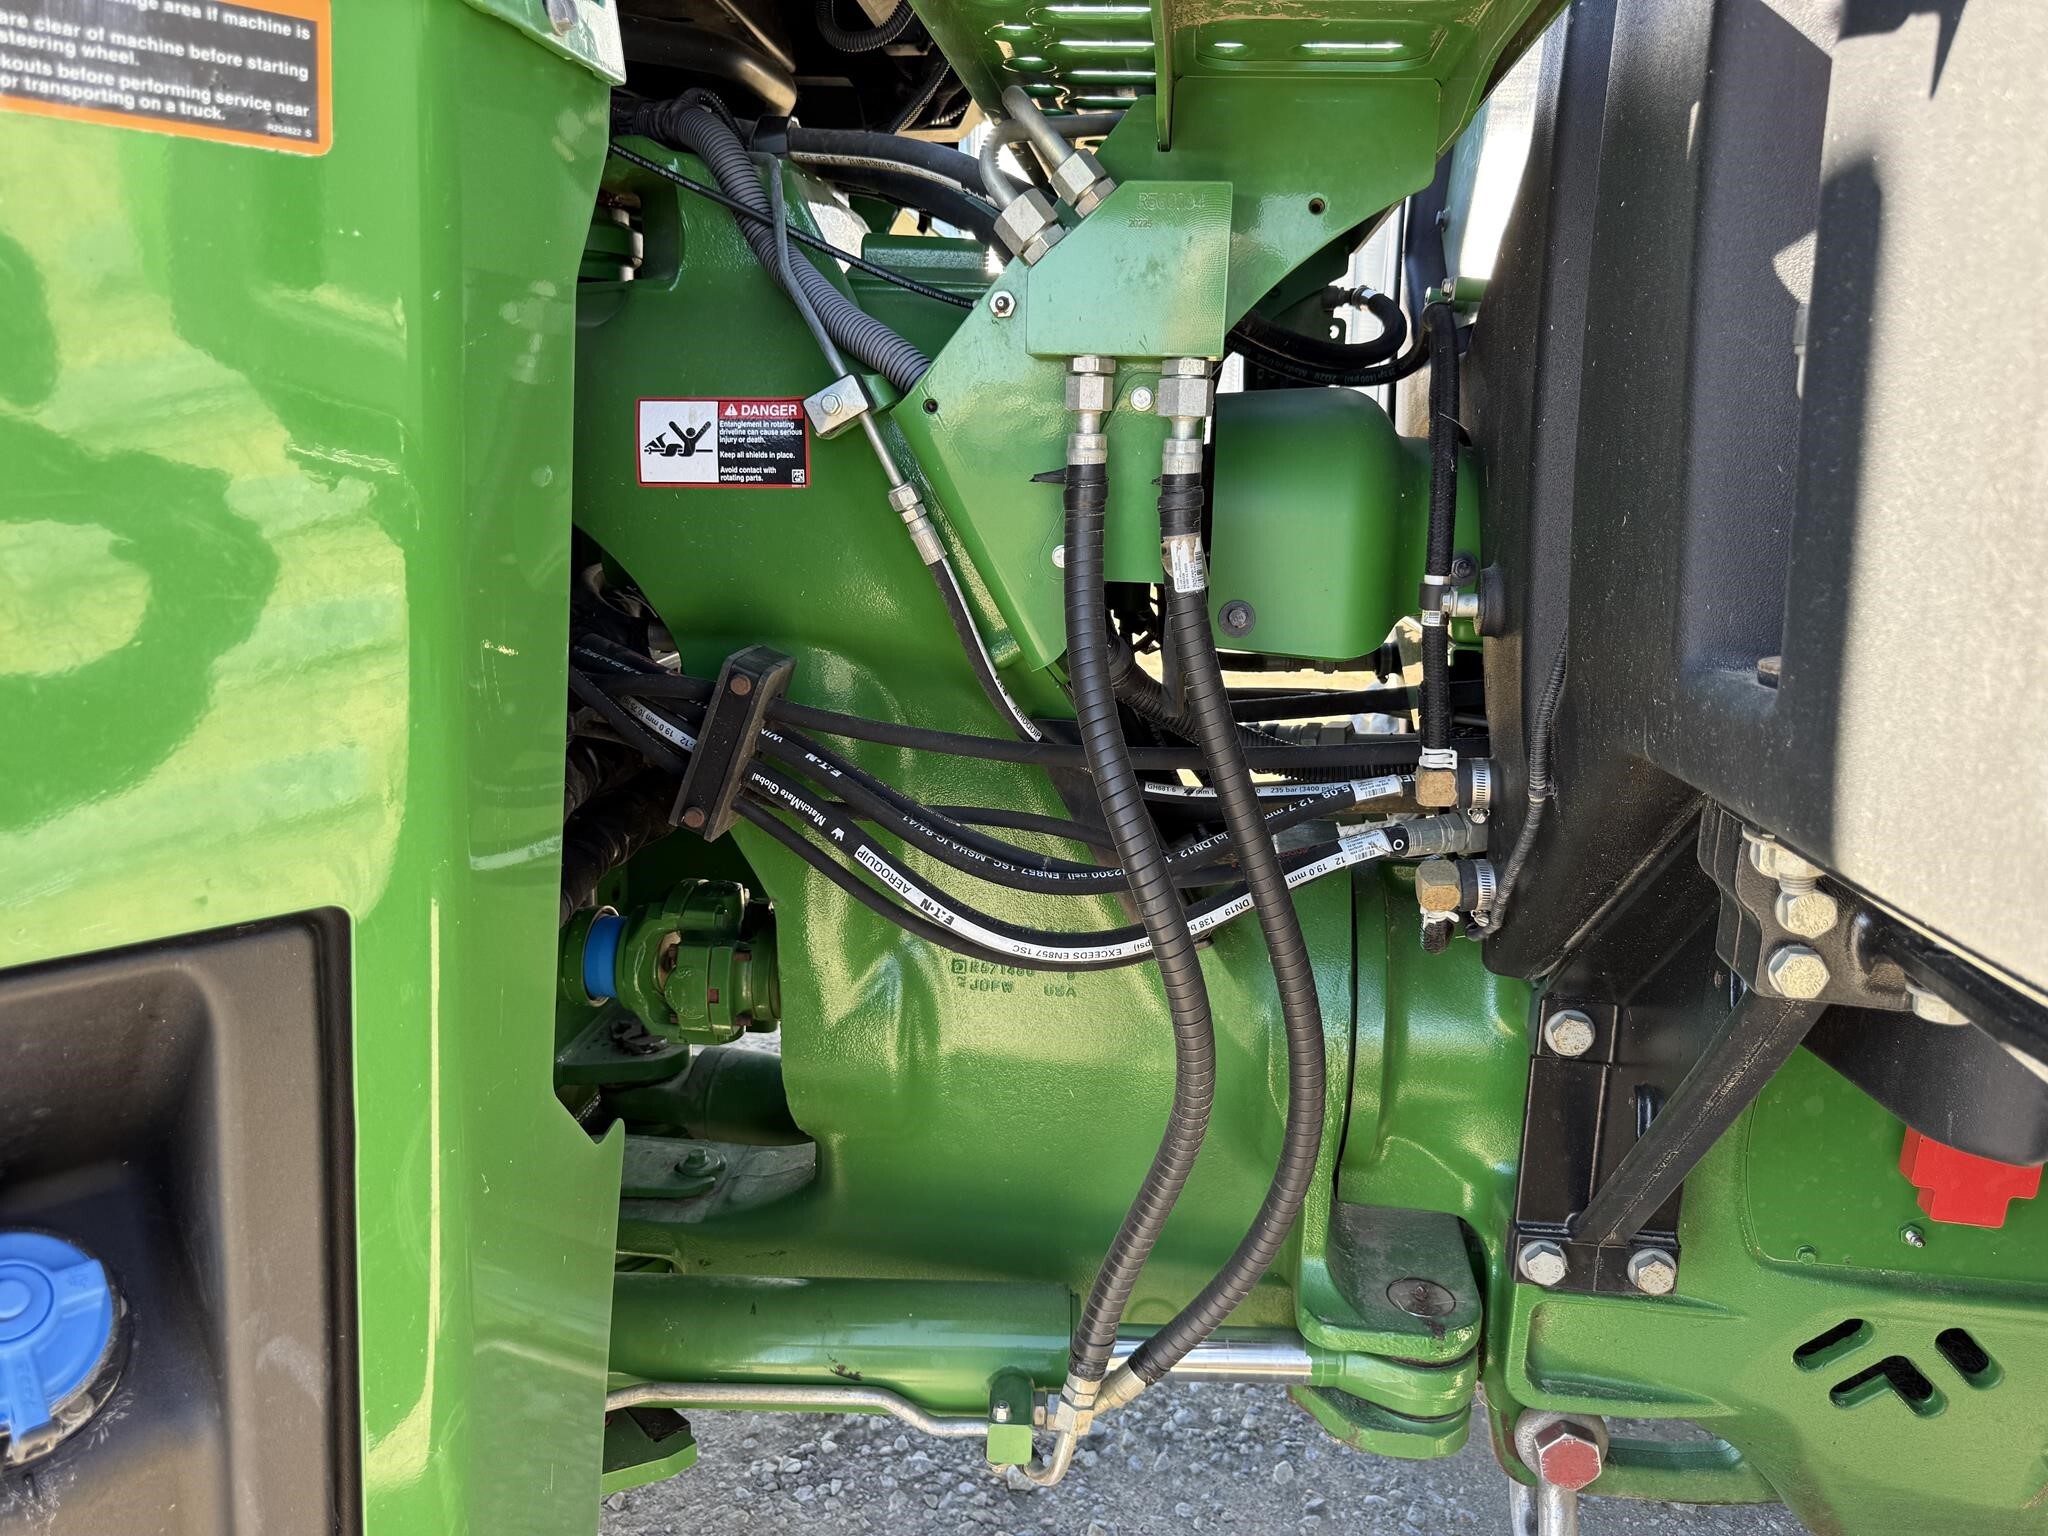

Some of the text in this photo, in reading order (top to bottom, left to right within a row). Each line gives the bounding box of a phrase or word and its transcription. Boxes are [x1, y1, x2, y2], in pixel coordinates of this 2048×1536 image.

[163, 1, 202, 19] area
[207, 6, 218, 22] if
[222, 11, 292, 36] machine
[295, 24, 310, 40] is
[0, 11, 309, 82] are clear of machine before starting
[0, 29, 140, 66] steering wheel.
[57, 61, 115, 86] before
[119, 74, 211, 105] performing
[215, 91, 272, 112] service
[275, 101, 309, 117] near
[23, 76, 135, 110] transporting
[138, 95, 161, 111] on
[165, 101, 176, 113] a
[179, 101, 226, 121] truck.
[741, 404, 798, 416] DANGER
[719, 421, 762, 429] Entanglement
[771, 421, 795, 429] rotating
[719, 436, 738, 445] injury
[719, 451, 736, 459] Keep
[776, 451, 796, 460] place.
[763, 466, 777, 474] with
[720, 474, 764, 483] rotating parts.
[1285, 786, 1297, 794] bar
[751, 771, 827, 827] MatchMate Global
[857, 848, 911, 894] AEROQUIP
[1224, 899, 1250, 917] DN19
[1196, 916, 1215, 931] 138
[1012, 944, 1032, 956] 1SC
[1036, 949, 1070, 960] EN857
[1073, 948, 1122, 960] EXCEEDS
